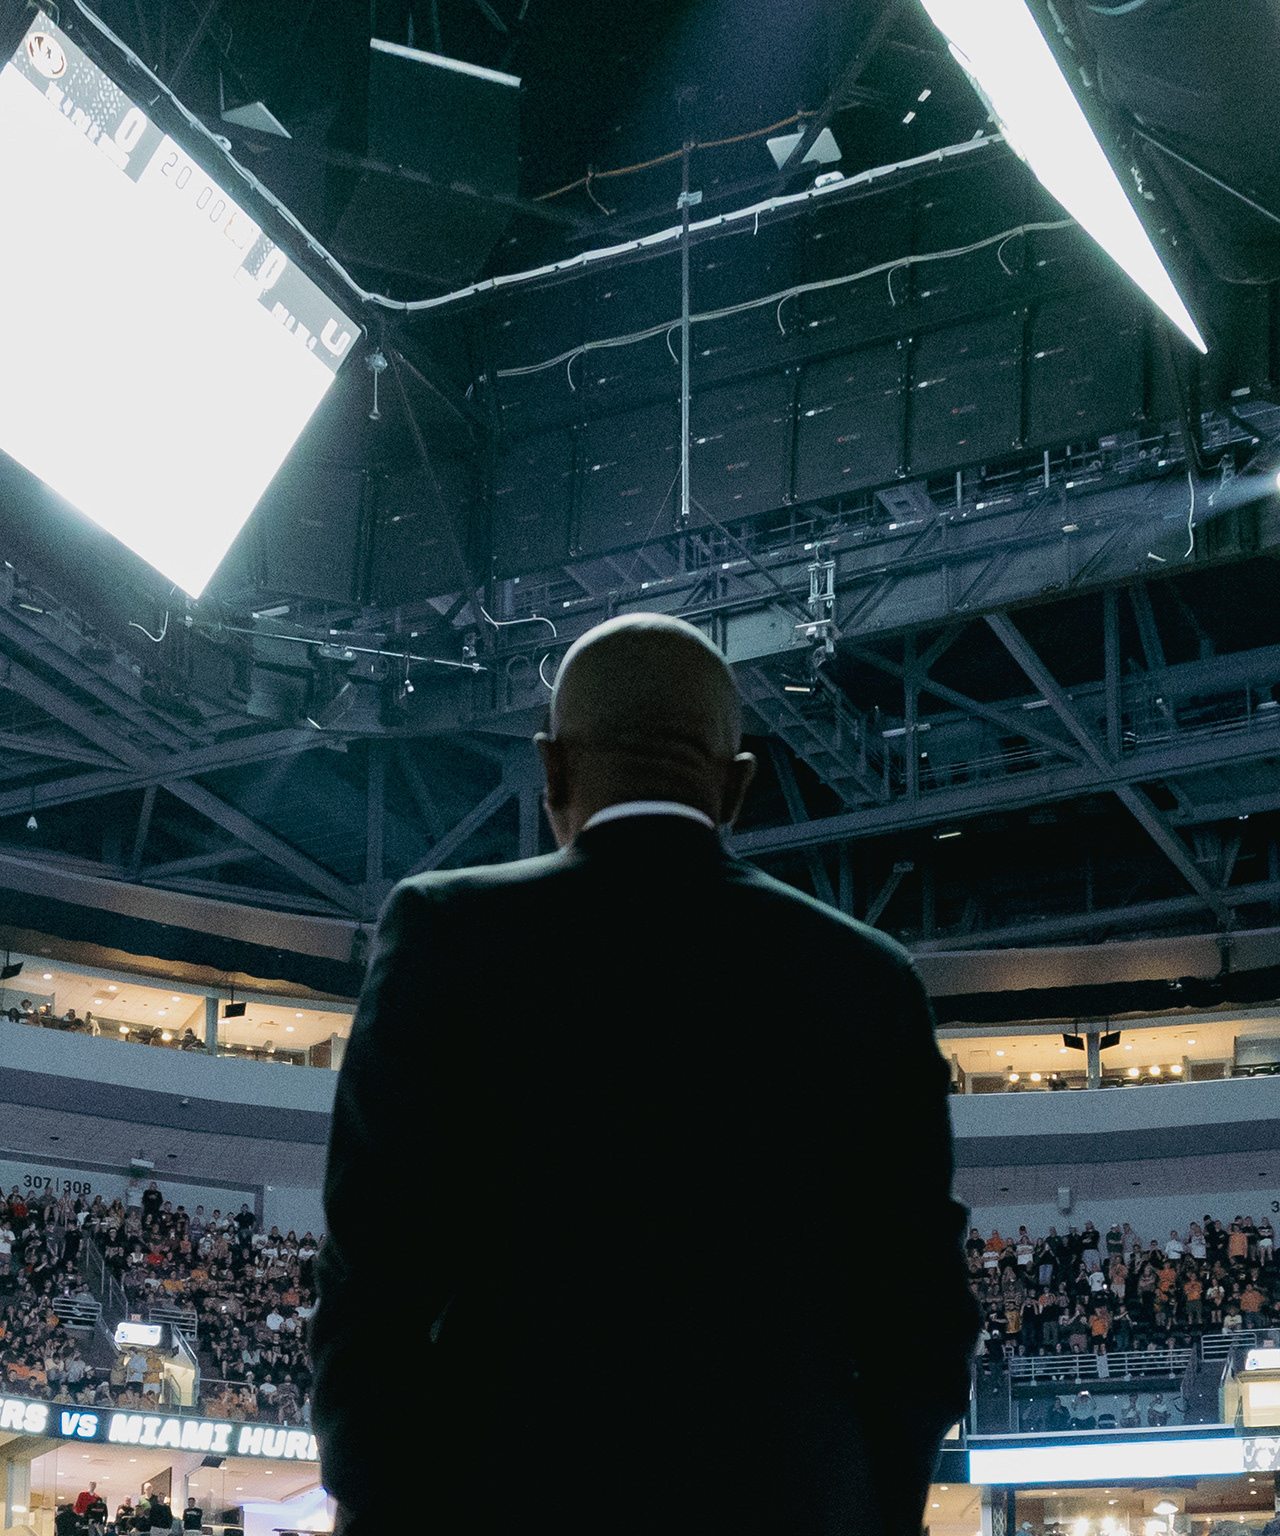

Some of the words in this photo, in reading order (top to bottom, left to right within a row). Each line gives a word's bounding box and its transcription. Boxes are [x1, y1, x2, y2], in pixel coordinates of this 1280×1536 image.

[115, 107, 148, 153] 0
[23, 1174, 52, 1190] 307
[63, 1180, 92, 1195] 308
[60, 1410, 99, 1438] VS
[108, 1413, 233, 1453] MIAMI
[237, 1426, 318, 1461] HUR
